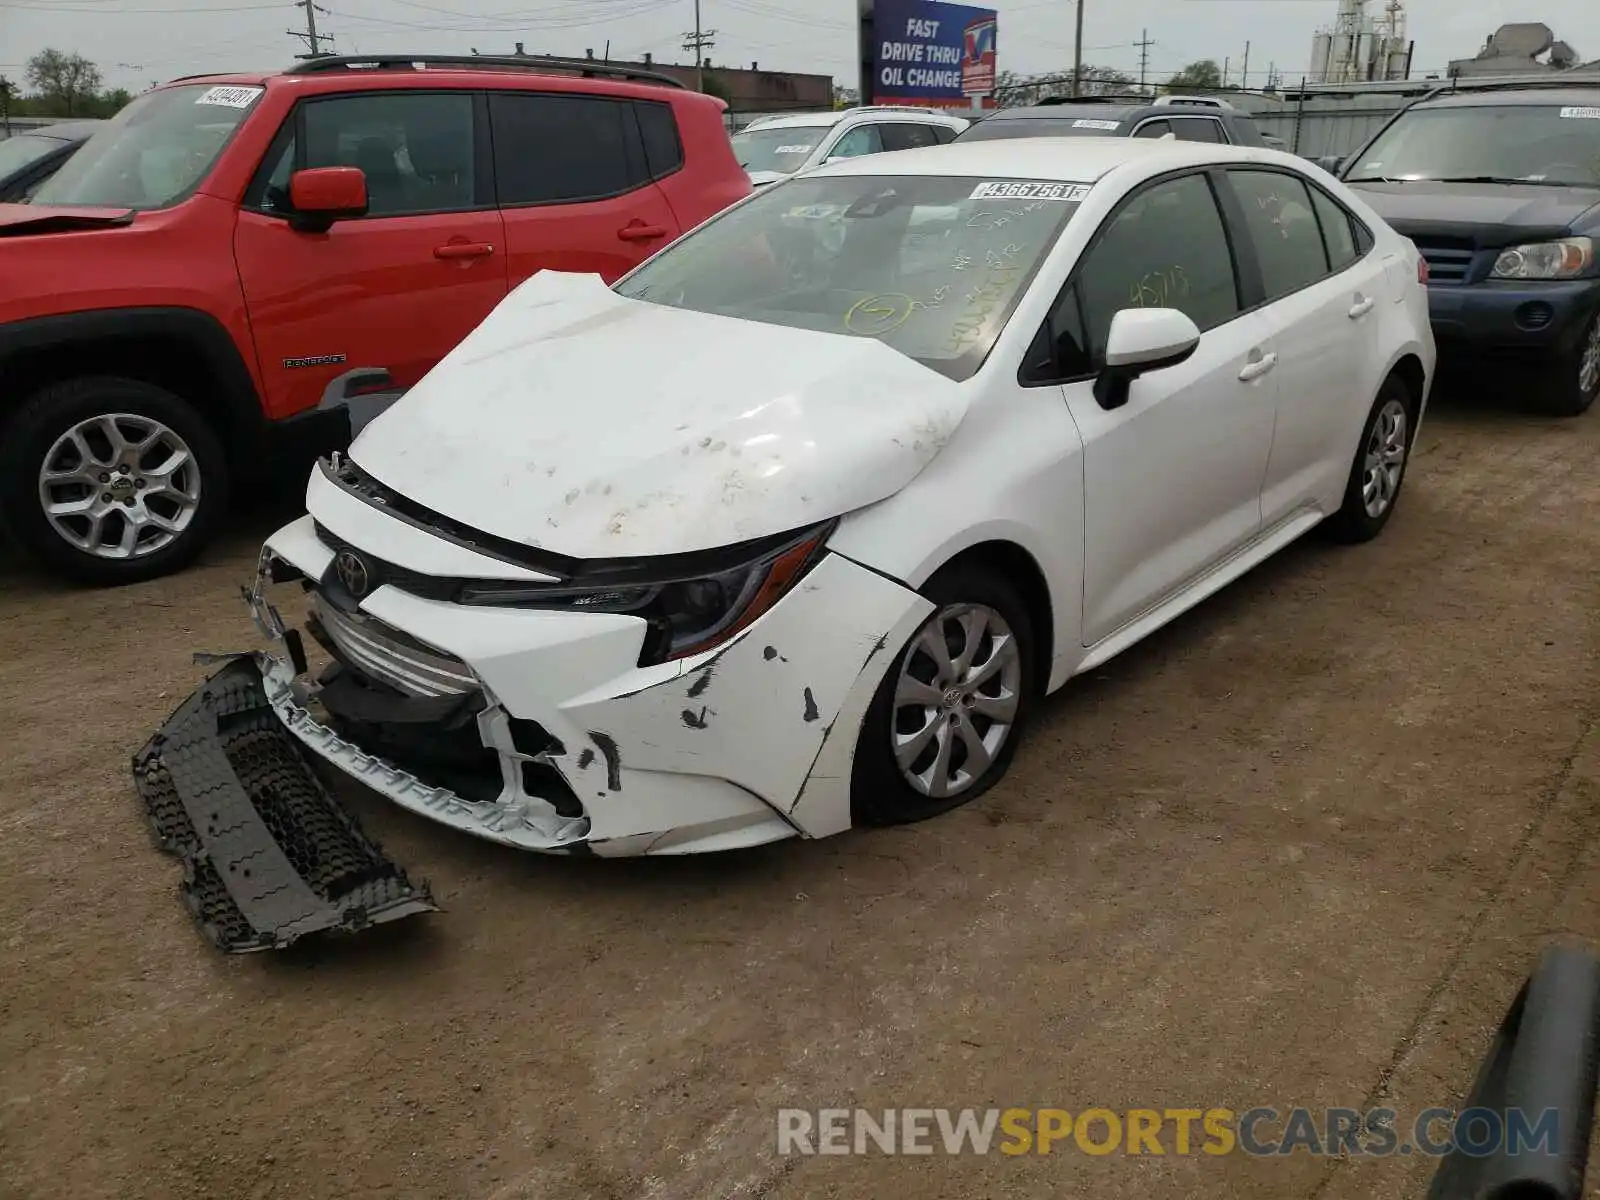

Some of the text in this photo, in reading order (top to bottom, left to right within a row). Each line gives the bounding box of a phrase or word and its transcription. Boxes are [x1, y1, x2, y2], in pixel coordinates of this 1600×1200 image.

[906, 18, 940, 38] FAST
[882, 41, 961, 65] DRIVE THRU
[881, 67, 905, 86] OIL
[907, 68, 961, 88] CHANGE
[983, 183, 1074, 199] 43667561
[283, 355, 346, 368] RENEGADE
